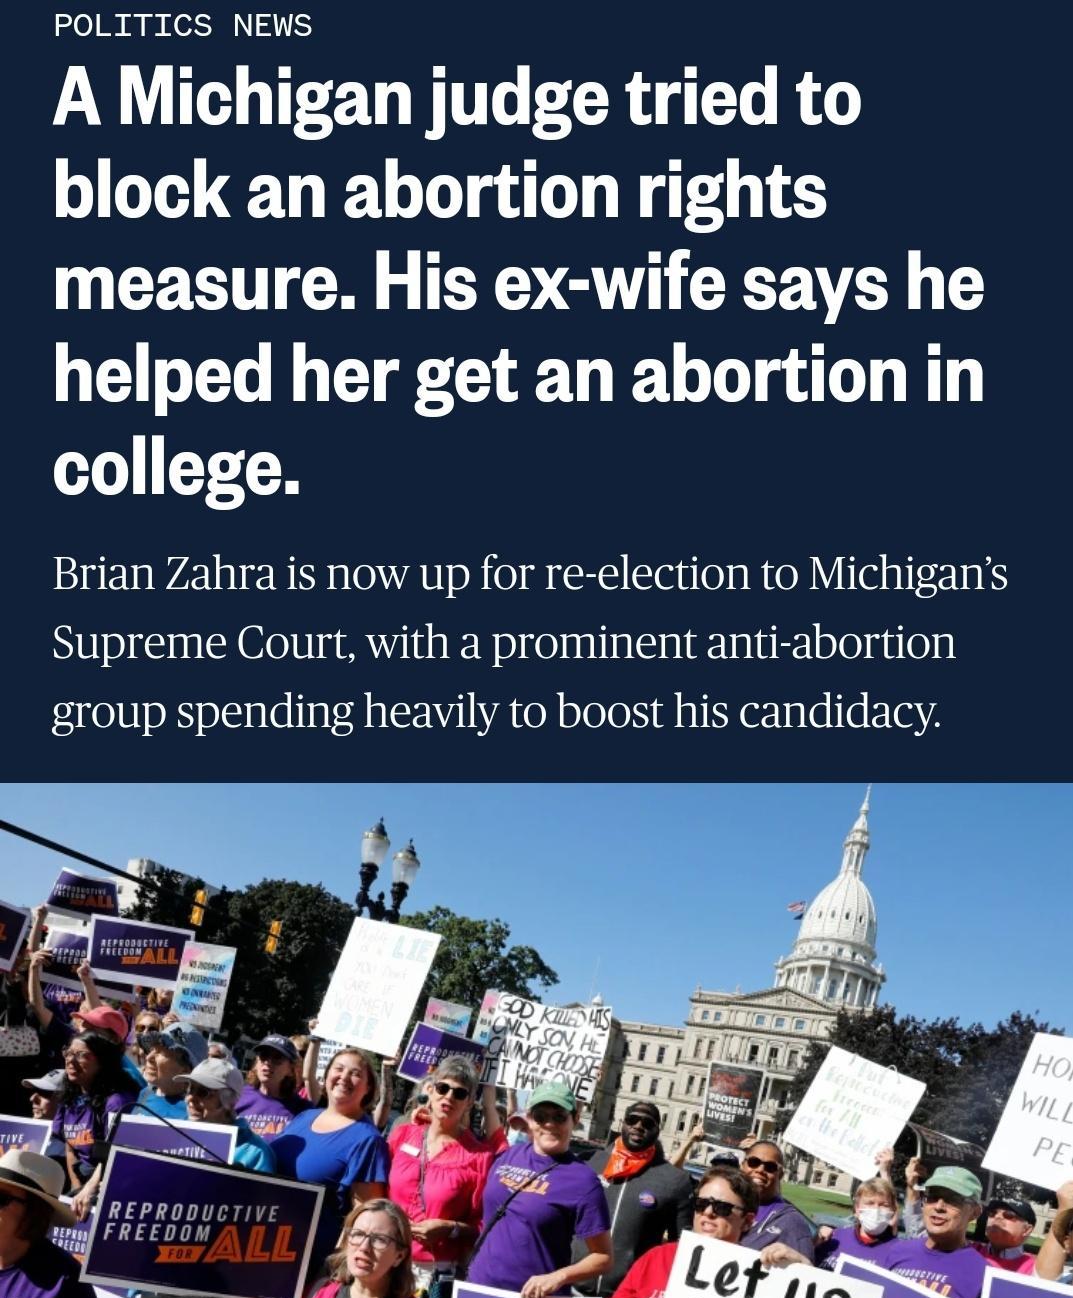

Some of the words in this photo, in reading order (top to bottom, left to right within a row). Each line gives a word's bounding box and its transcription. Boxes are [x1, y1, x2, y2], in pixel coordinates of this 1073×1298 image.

[52, 947, 87, 958] REPROD
[100, 939, 169, 948] REPRODUCTIVE
[100, 947, 142, 956] FREEDOM
[140, 948, 179, 965] ALL
[500, 995, 535, 1019] GOD
[541, 1008, 587, 1027] KILLED
[588, 1006, 612, 1032] HIS
[492, 1015, 538, 1041] ONLY
[480, 1057, 498, 1083] IF
[487, 1037, 547, 1066] CANNOT
[548, 1051, 601, 1081] CHOOSE
[1032, 1053, 1073, 1081] HO
[708, 1092, 750, 1107] PROTECT
[1021, 1091, 1073, 1124] WILL
[706, 1109, 736, 1123] LIVES!
[1032, 1137, 1073, 1167] PE
[108, 1201, 280, 1223] REPRODUCTIVE
[53, 1226, 88, 1242] REPROD
[103, 1222, 211, 1242] FREEDOM
[167, 1246, 193, 1260] FOR
[202, 1225, 297, 1264] ALL
